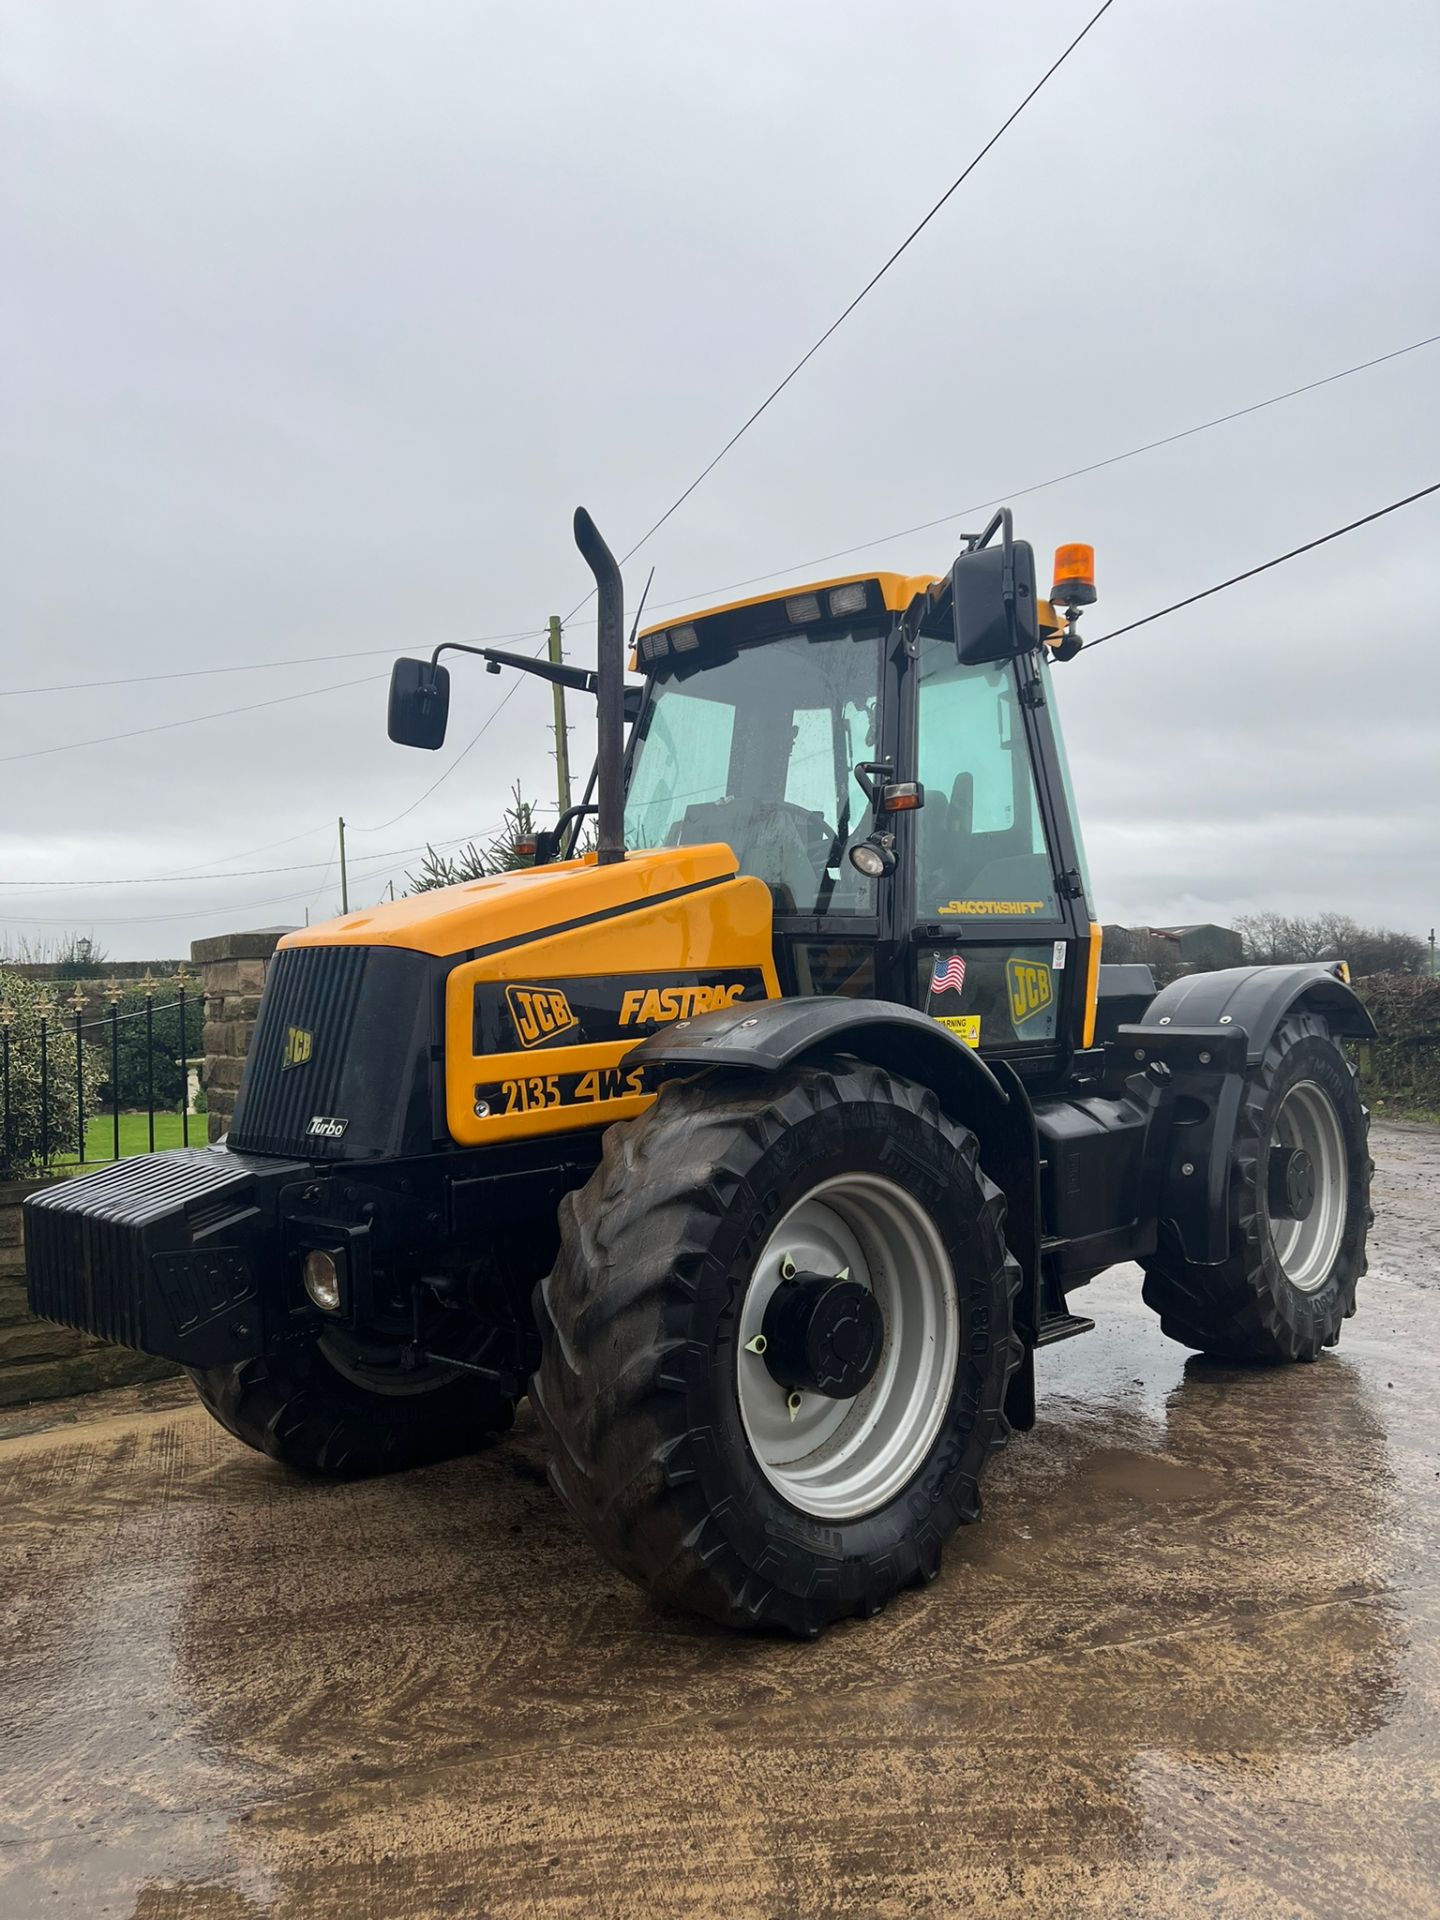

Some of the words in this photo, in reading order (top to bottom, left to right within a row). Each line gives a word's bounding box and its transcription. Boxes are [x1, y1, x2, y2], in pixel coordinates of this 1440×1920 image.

[618, 984, 745, 1026] FASTRAC
[1013, 965, 1050, 1017] JCB
[515, 991, 571, 1040] JCB
[282, 1026, 312, 1068] JCB
[501, 1075, 561, 1115] 2135
[574, 1066, 645, 1103] 4WS
[309, 1117, 344, 1136] Turbo
